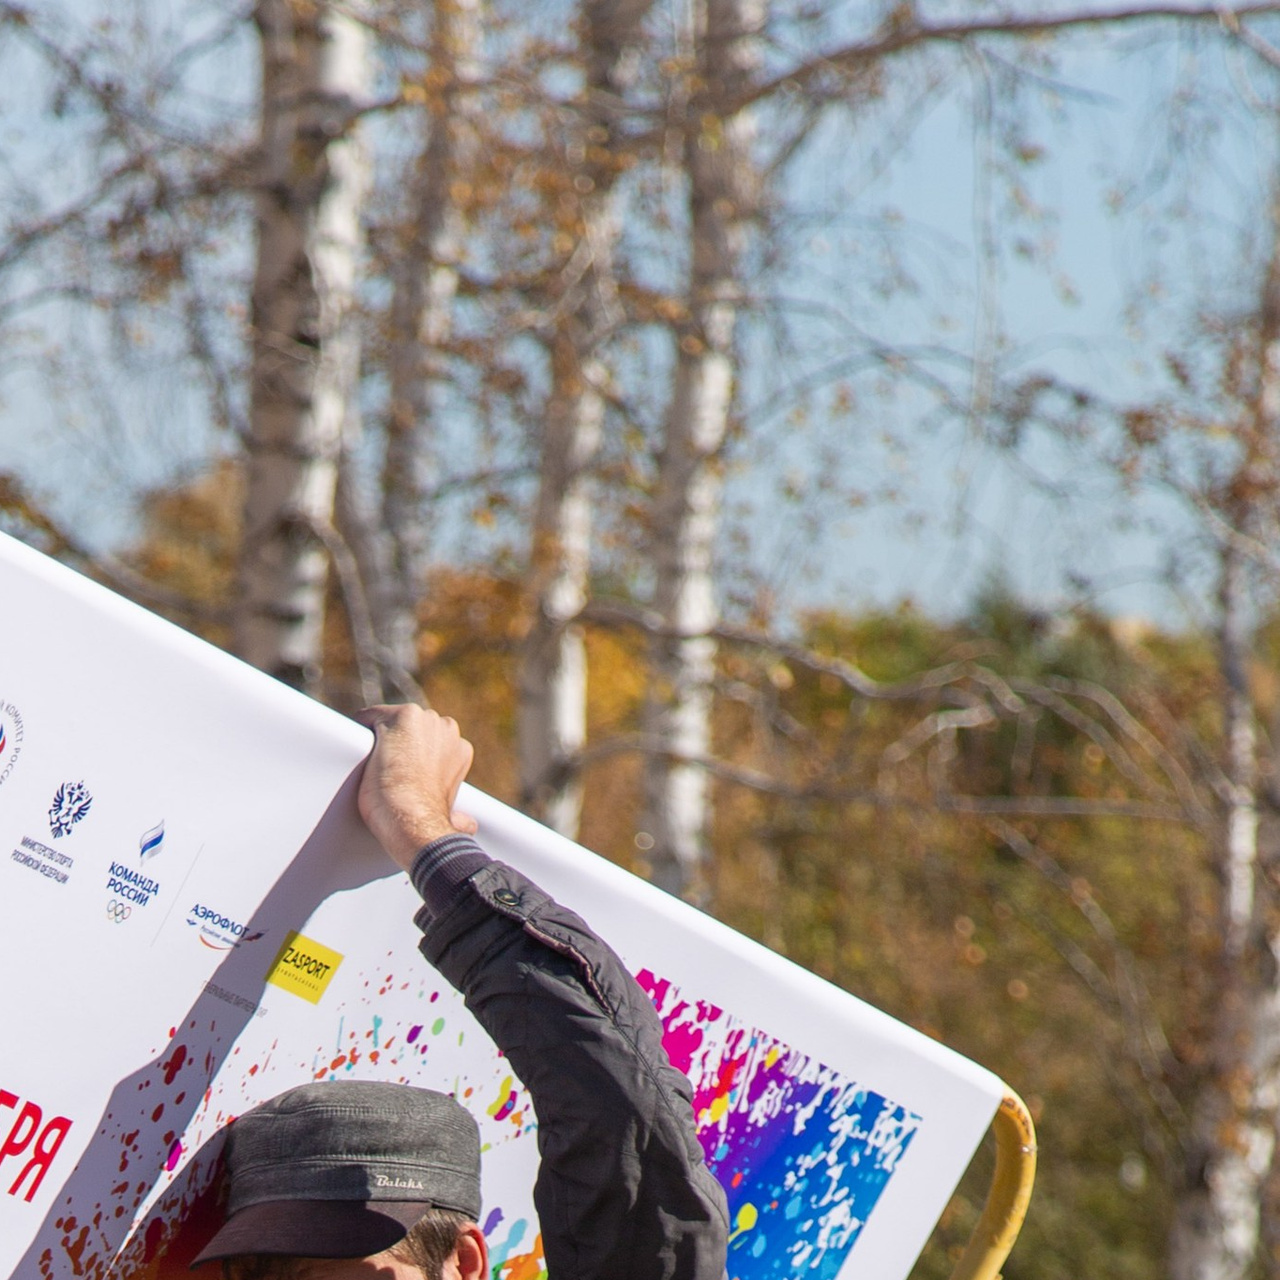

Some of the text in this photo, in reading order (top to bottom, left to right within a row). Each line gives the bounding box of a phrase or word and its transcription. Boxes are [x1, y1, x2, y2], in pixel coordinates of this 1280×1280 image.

[6, 702, 24, 743] КОМИТЕТ
[106, 877, 150, 907] РОССИИ
[107, 861, 160, 896] КОМАНДА
[190, 903, 250, 938] АЭРОФЛОТ
[282, 947, 331, 980] ZASPORT
